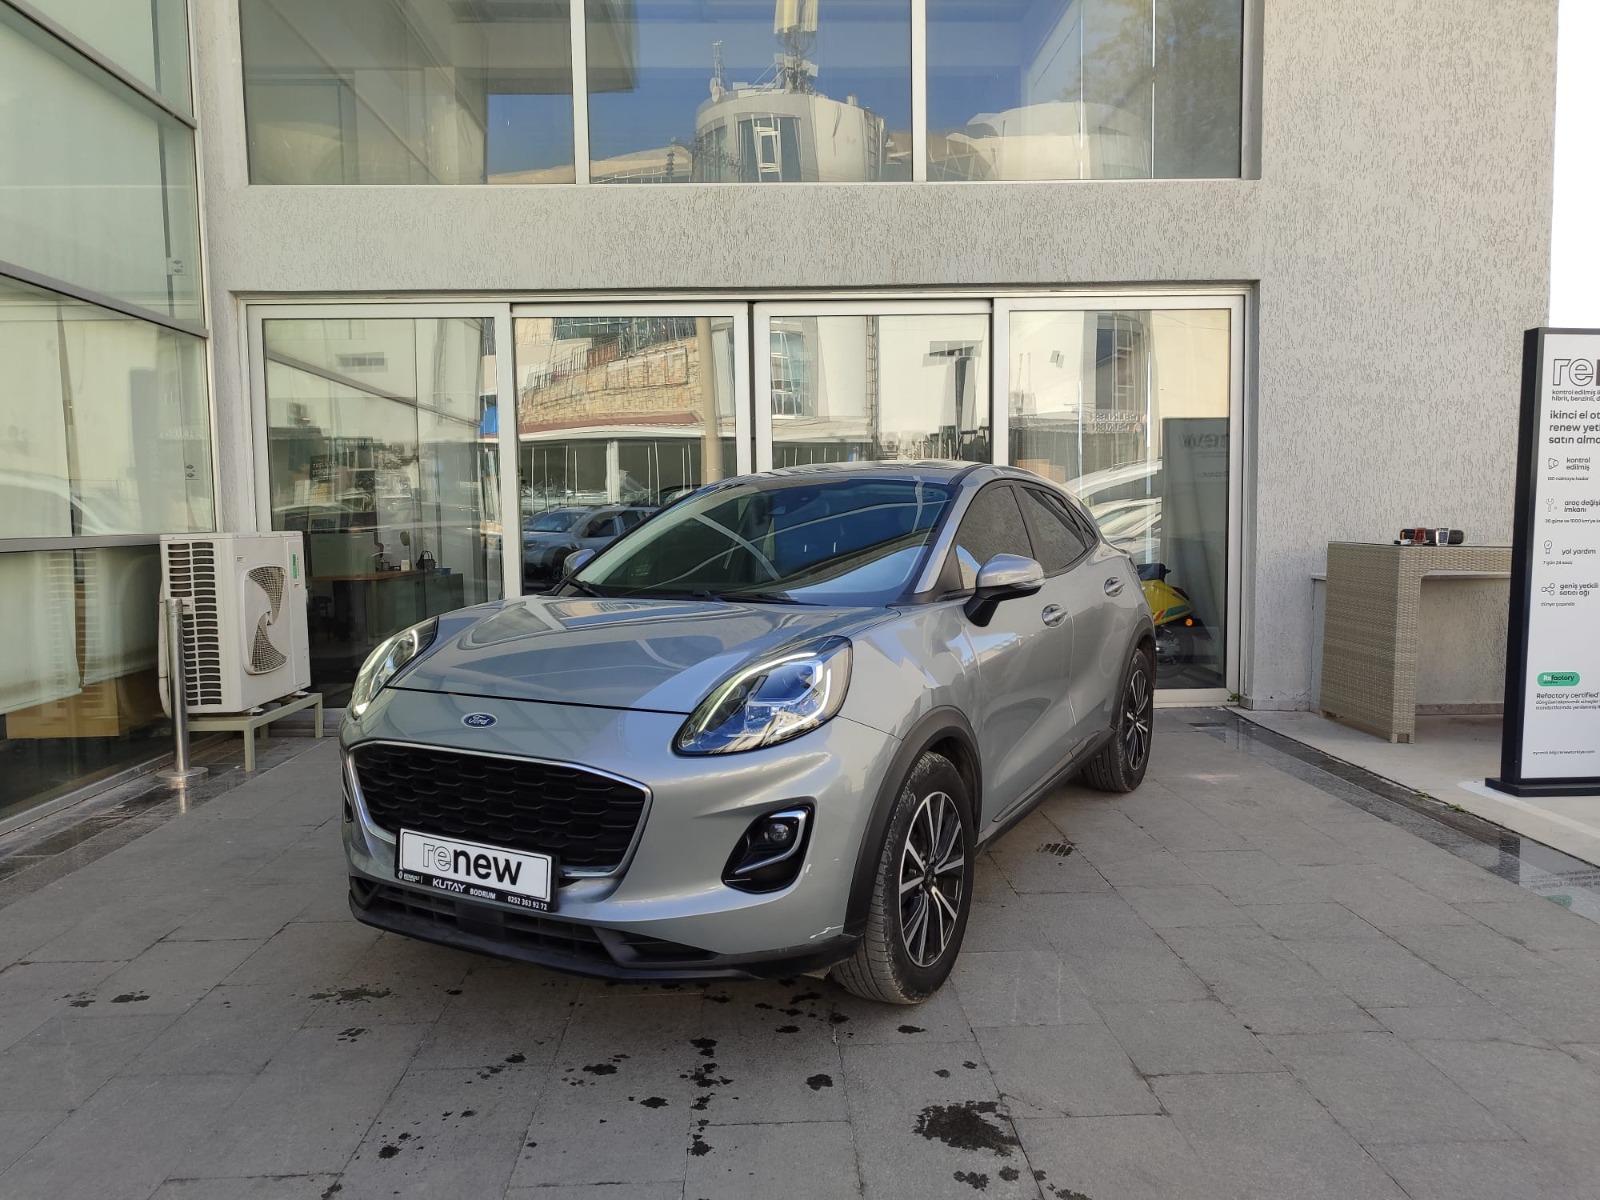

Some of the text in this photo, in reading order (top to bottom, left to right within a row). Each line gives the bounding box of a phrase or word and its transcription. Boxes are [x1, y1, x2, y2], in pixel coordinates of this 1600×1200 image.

[1552, 358, 1600, 386] re
[1550, 410, 1577, 420] ikinci
[1579, 410, 1588, 420] el
[1549, 424, 1581, 432] renew
[1549, 436, 1574, 444] satın
[1566, 456, 1591, 464] kontrol
[1561, 548, 1572, 556] yol
[1536, 691, 1599, 700] Refactory certified
[422, 843, 522, 886] renew
[432, 878, 466, 893] KUTAY
[469, 888, 496, 900] BODRUM
[507, 895, 521, 905] 0252
